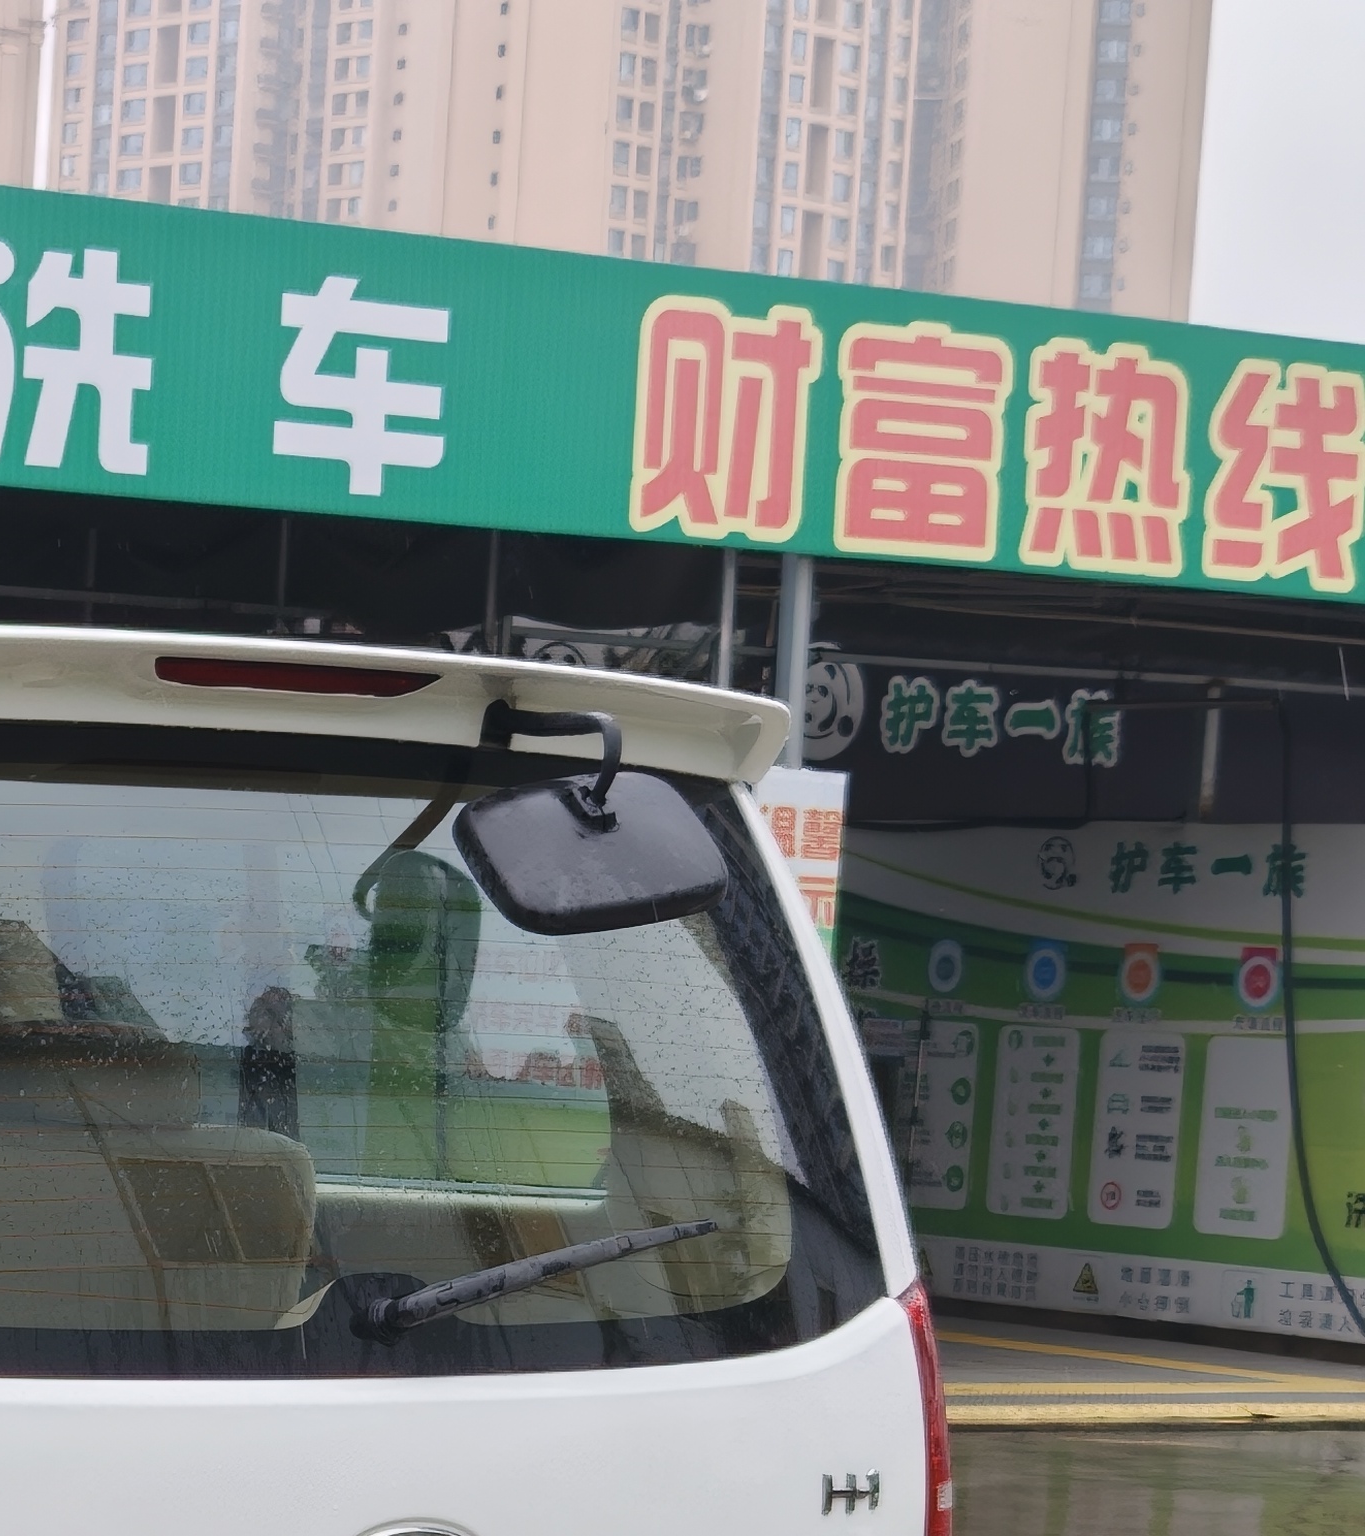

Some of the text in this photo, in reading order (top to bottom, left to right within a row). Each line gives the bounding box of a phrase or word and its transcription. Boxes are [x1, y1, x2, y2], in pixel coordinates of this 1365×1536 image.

[629, 294, 1365, 592] 财富热线
[880, 675, 1123, 768] 护车一族
